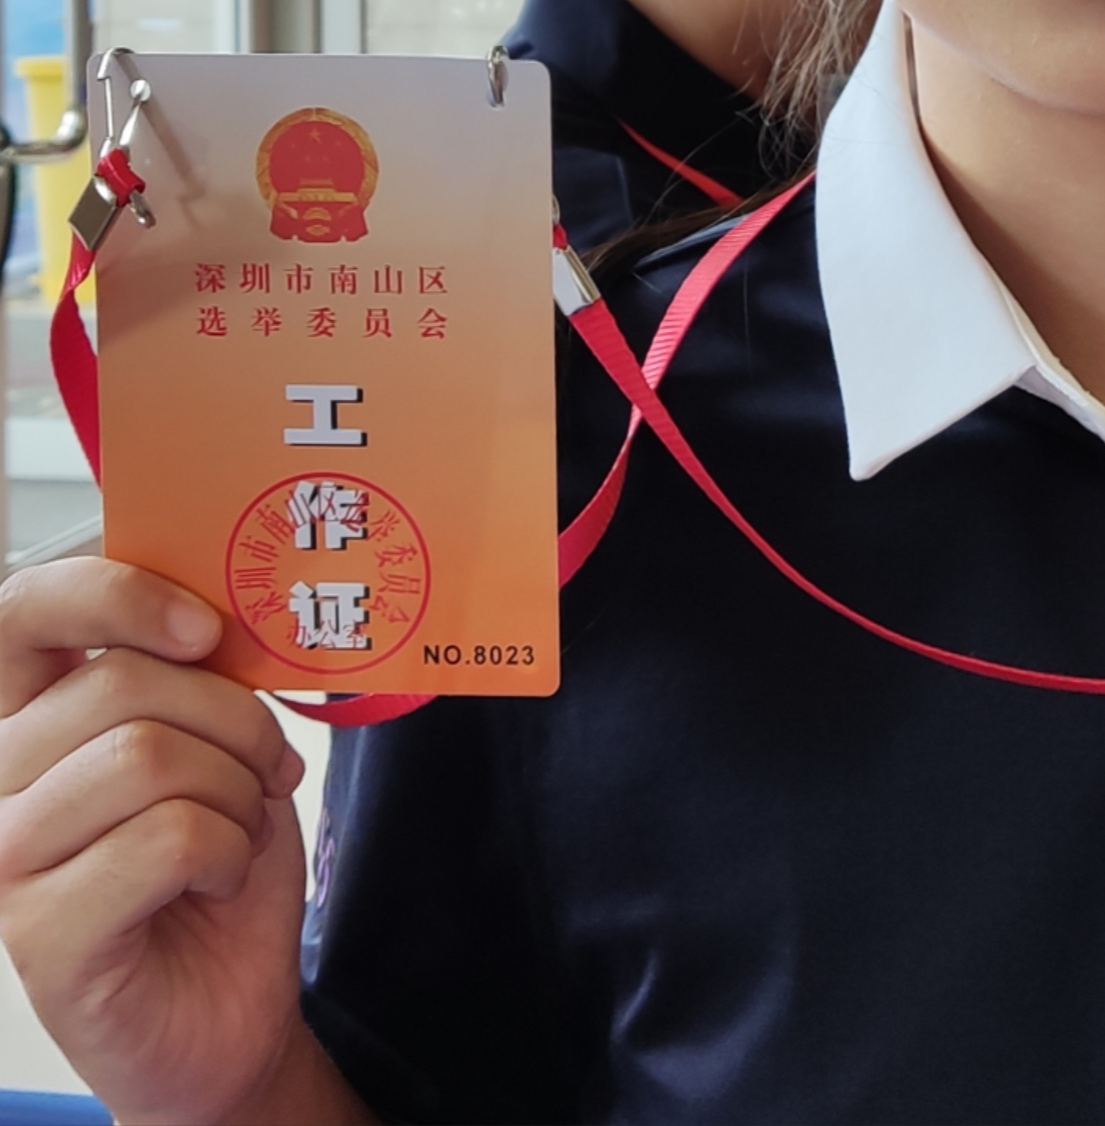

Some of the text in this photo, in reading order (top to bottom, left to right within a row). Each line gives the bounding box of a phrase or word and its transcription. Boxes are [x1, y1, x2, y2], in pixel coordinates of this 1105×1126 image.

[195, 262, 448, 295] 深圳市南山区
[196, 306, 448, 340] 选举委员会
[284, 384, 373, 651] 工作证
[286, 618, 367, 650] 办公室
[423, 644, 535, 666] NO.8023
